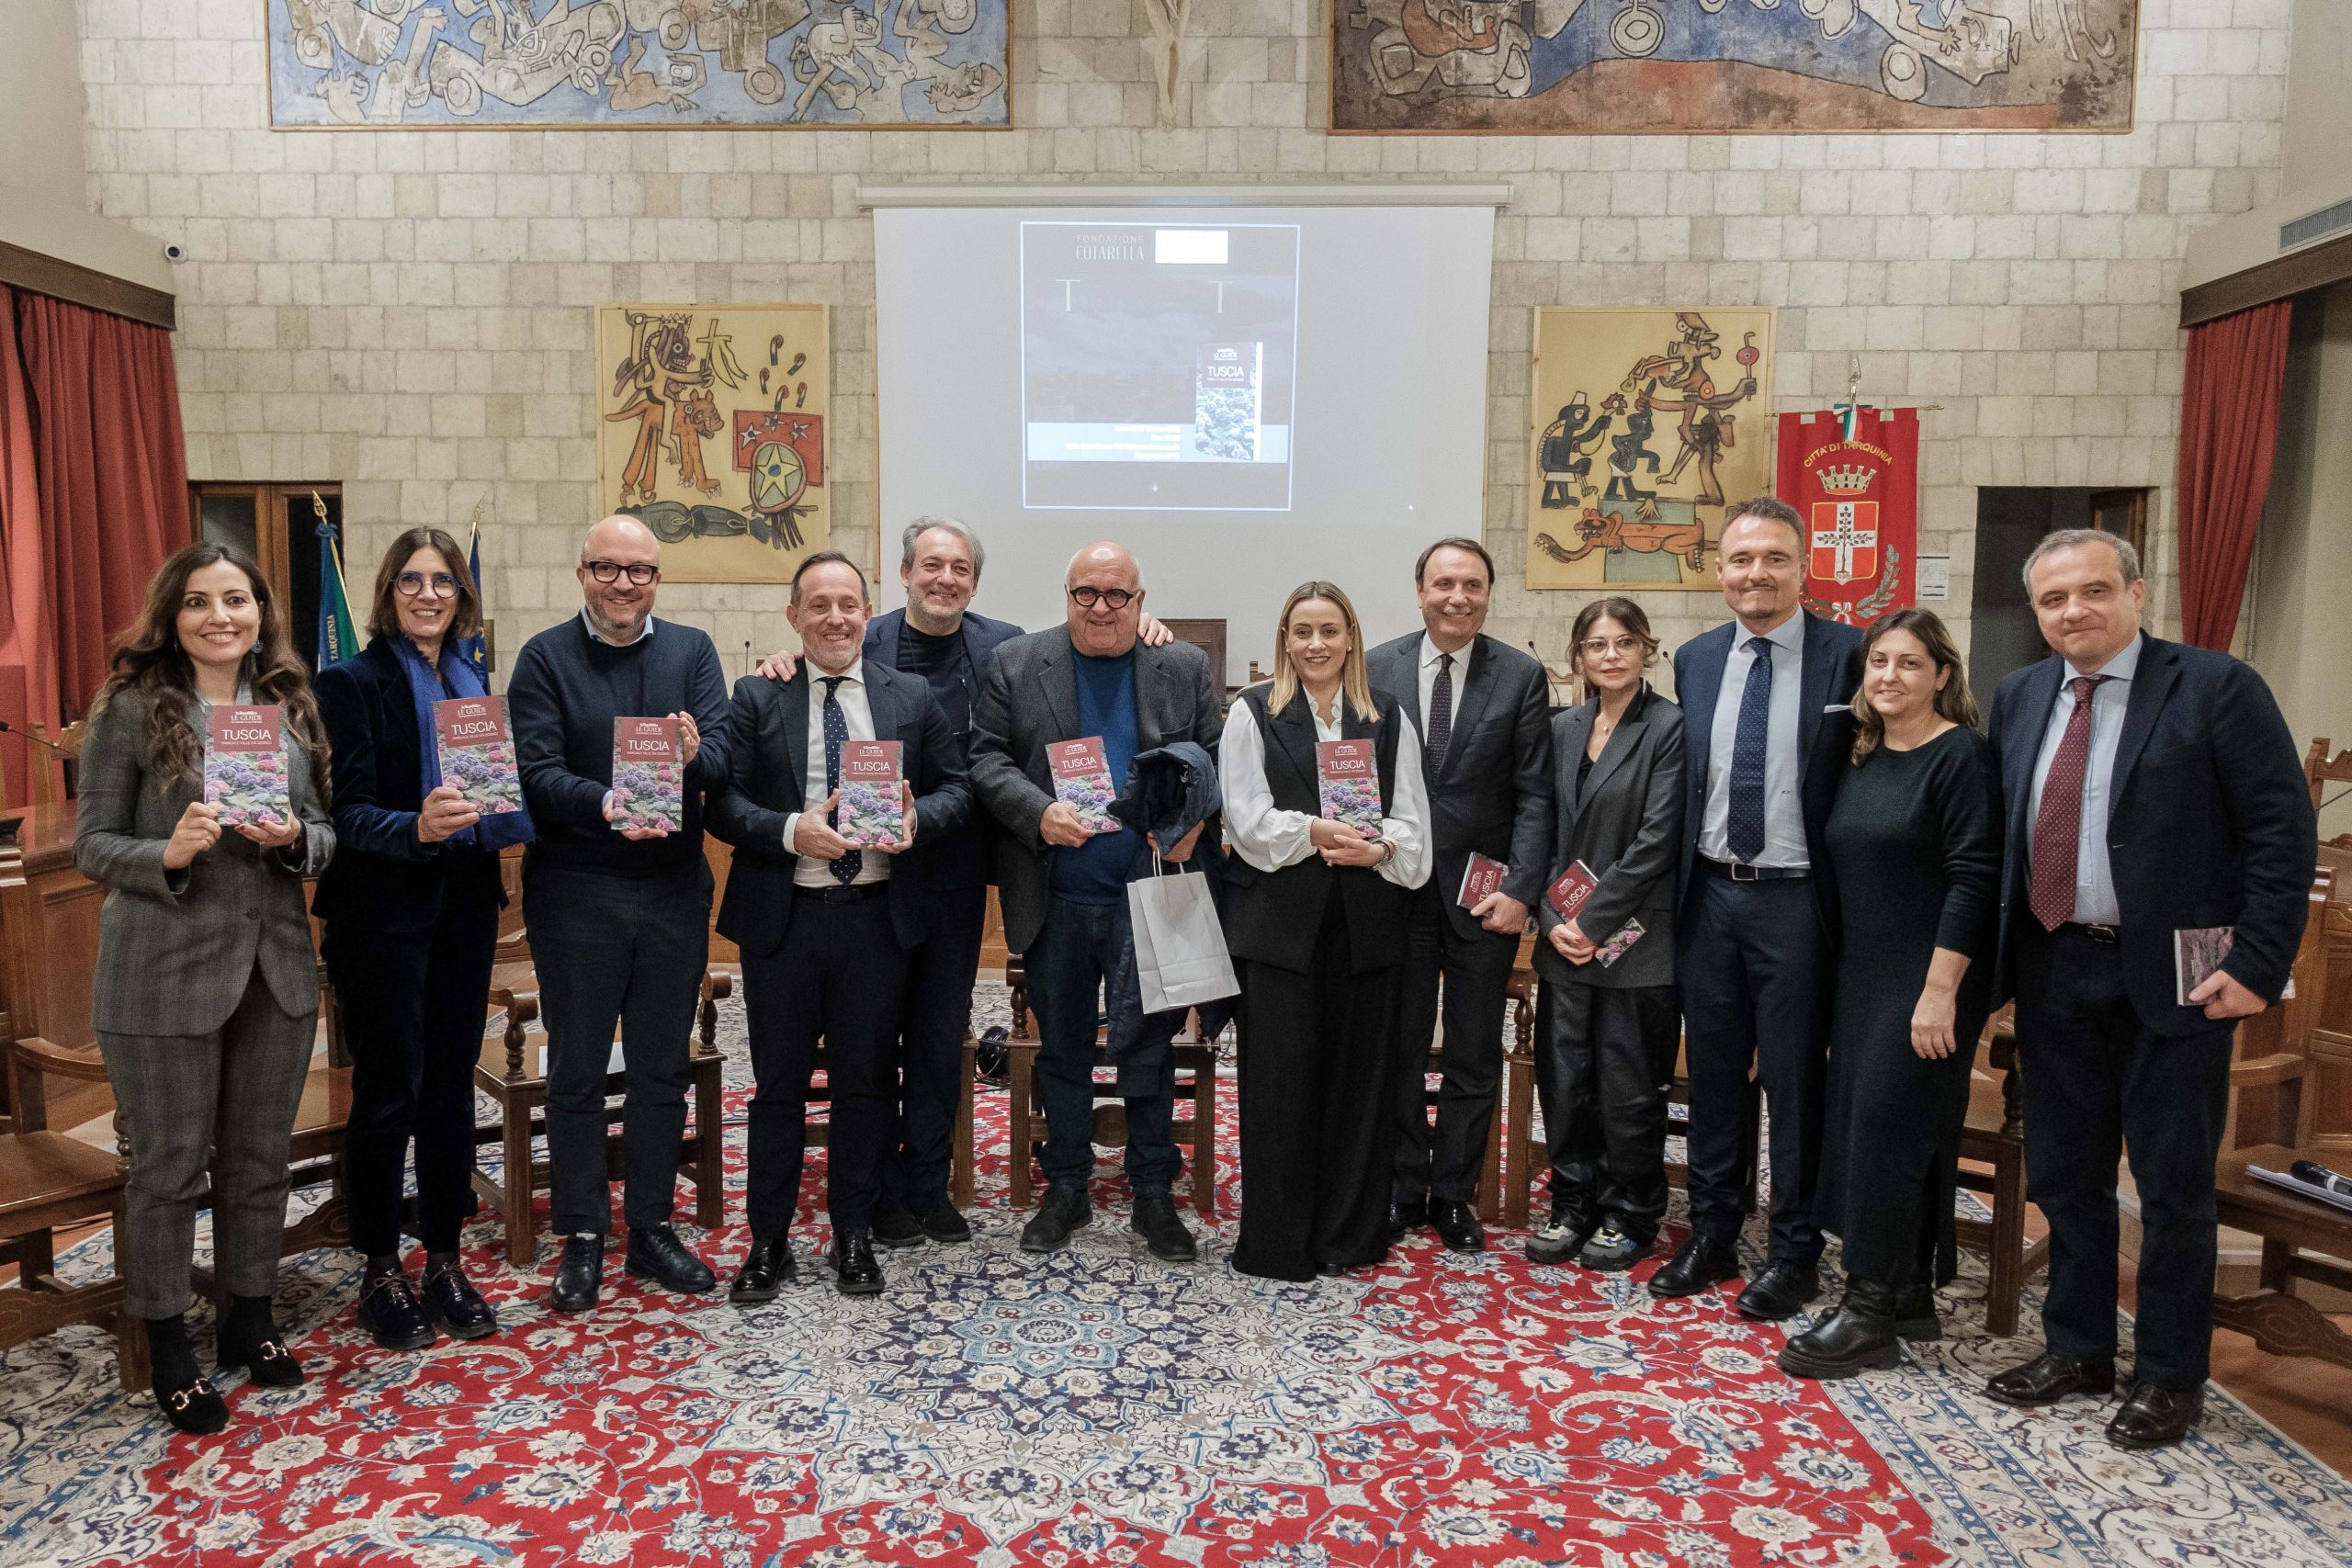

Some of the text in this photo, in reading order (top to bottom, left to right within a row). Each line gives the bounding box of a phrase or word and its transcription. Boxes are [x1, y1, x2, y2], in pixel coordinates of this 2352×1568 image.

[1077, 235, 1144, 243] FONDAZIONE
[1207, 366, 1244, 377] TUSCIA
[1804, 441, 1893, 468] CITTA' DI TARQUINIA
[326, 614, 339, 661] TARQUINIA
[451, 721, 497, 735] TUSCIA
[221, 729, 271, 740] TUSCIA
[628, 740, 670, 751] TUSCIA
[853, 761, 890, 772] TUSCIA
[1061, 756, 1097, 769] TUSCIA
[1329, 760, 1366, 770] TUSCIA
[1478, 870, 1494, 901] TUSCIA
[1562, 884, 1589, 908] TUSCIA
